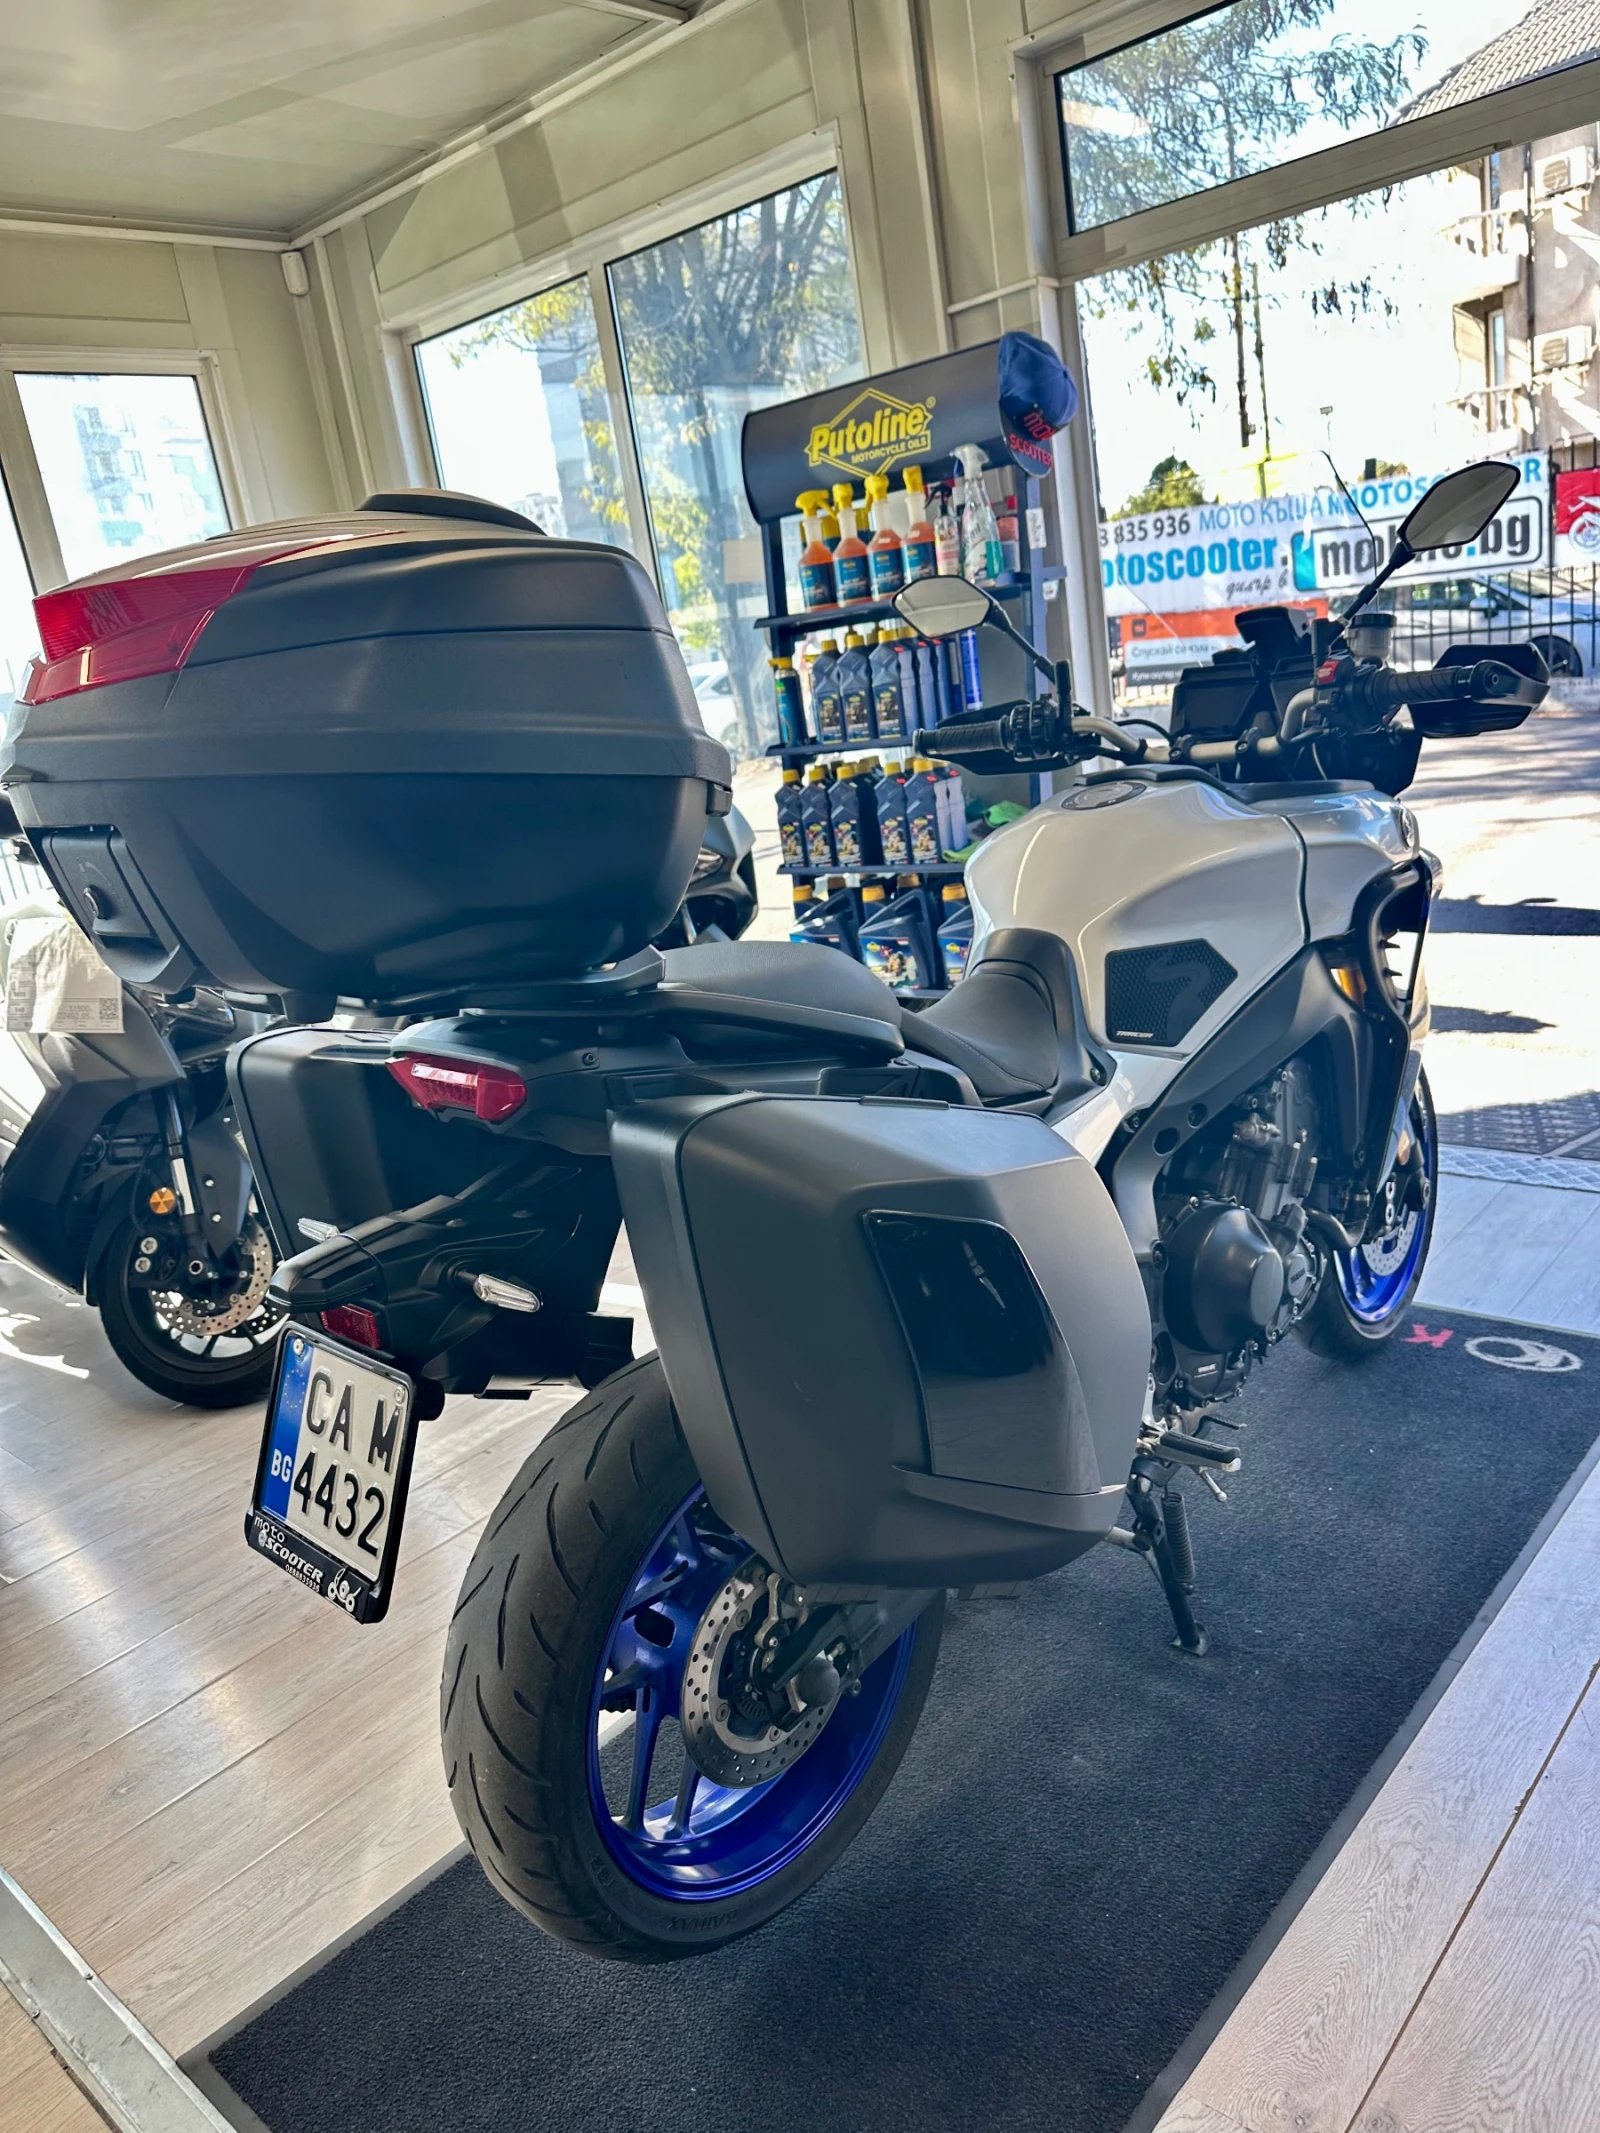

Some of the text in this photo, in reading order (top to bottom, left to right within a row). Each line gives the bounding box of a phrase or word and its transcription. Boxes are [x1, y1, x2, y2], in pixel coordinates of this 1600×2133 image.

[812, 407, 924, 462] Putoline
[851, 437, 927, 464] MOTORCYCLE OILS
[1114, 518, 1148, 545] 835
[1153, 513, 1190, 539] 936
[1199, 505, 1255, 532] МОТО
[306, 1370, 400, 1473] CA M
[270, 1448, 293, 1483] BG
[293, 1451, 385, 1557] 4432
[254, 1515, 285, 1543] moto
[265, 1537, 324, 1583] SCOOTER
